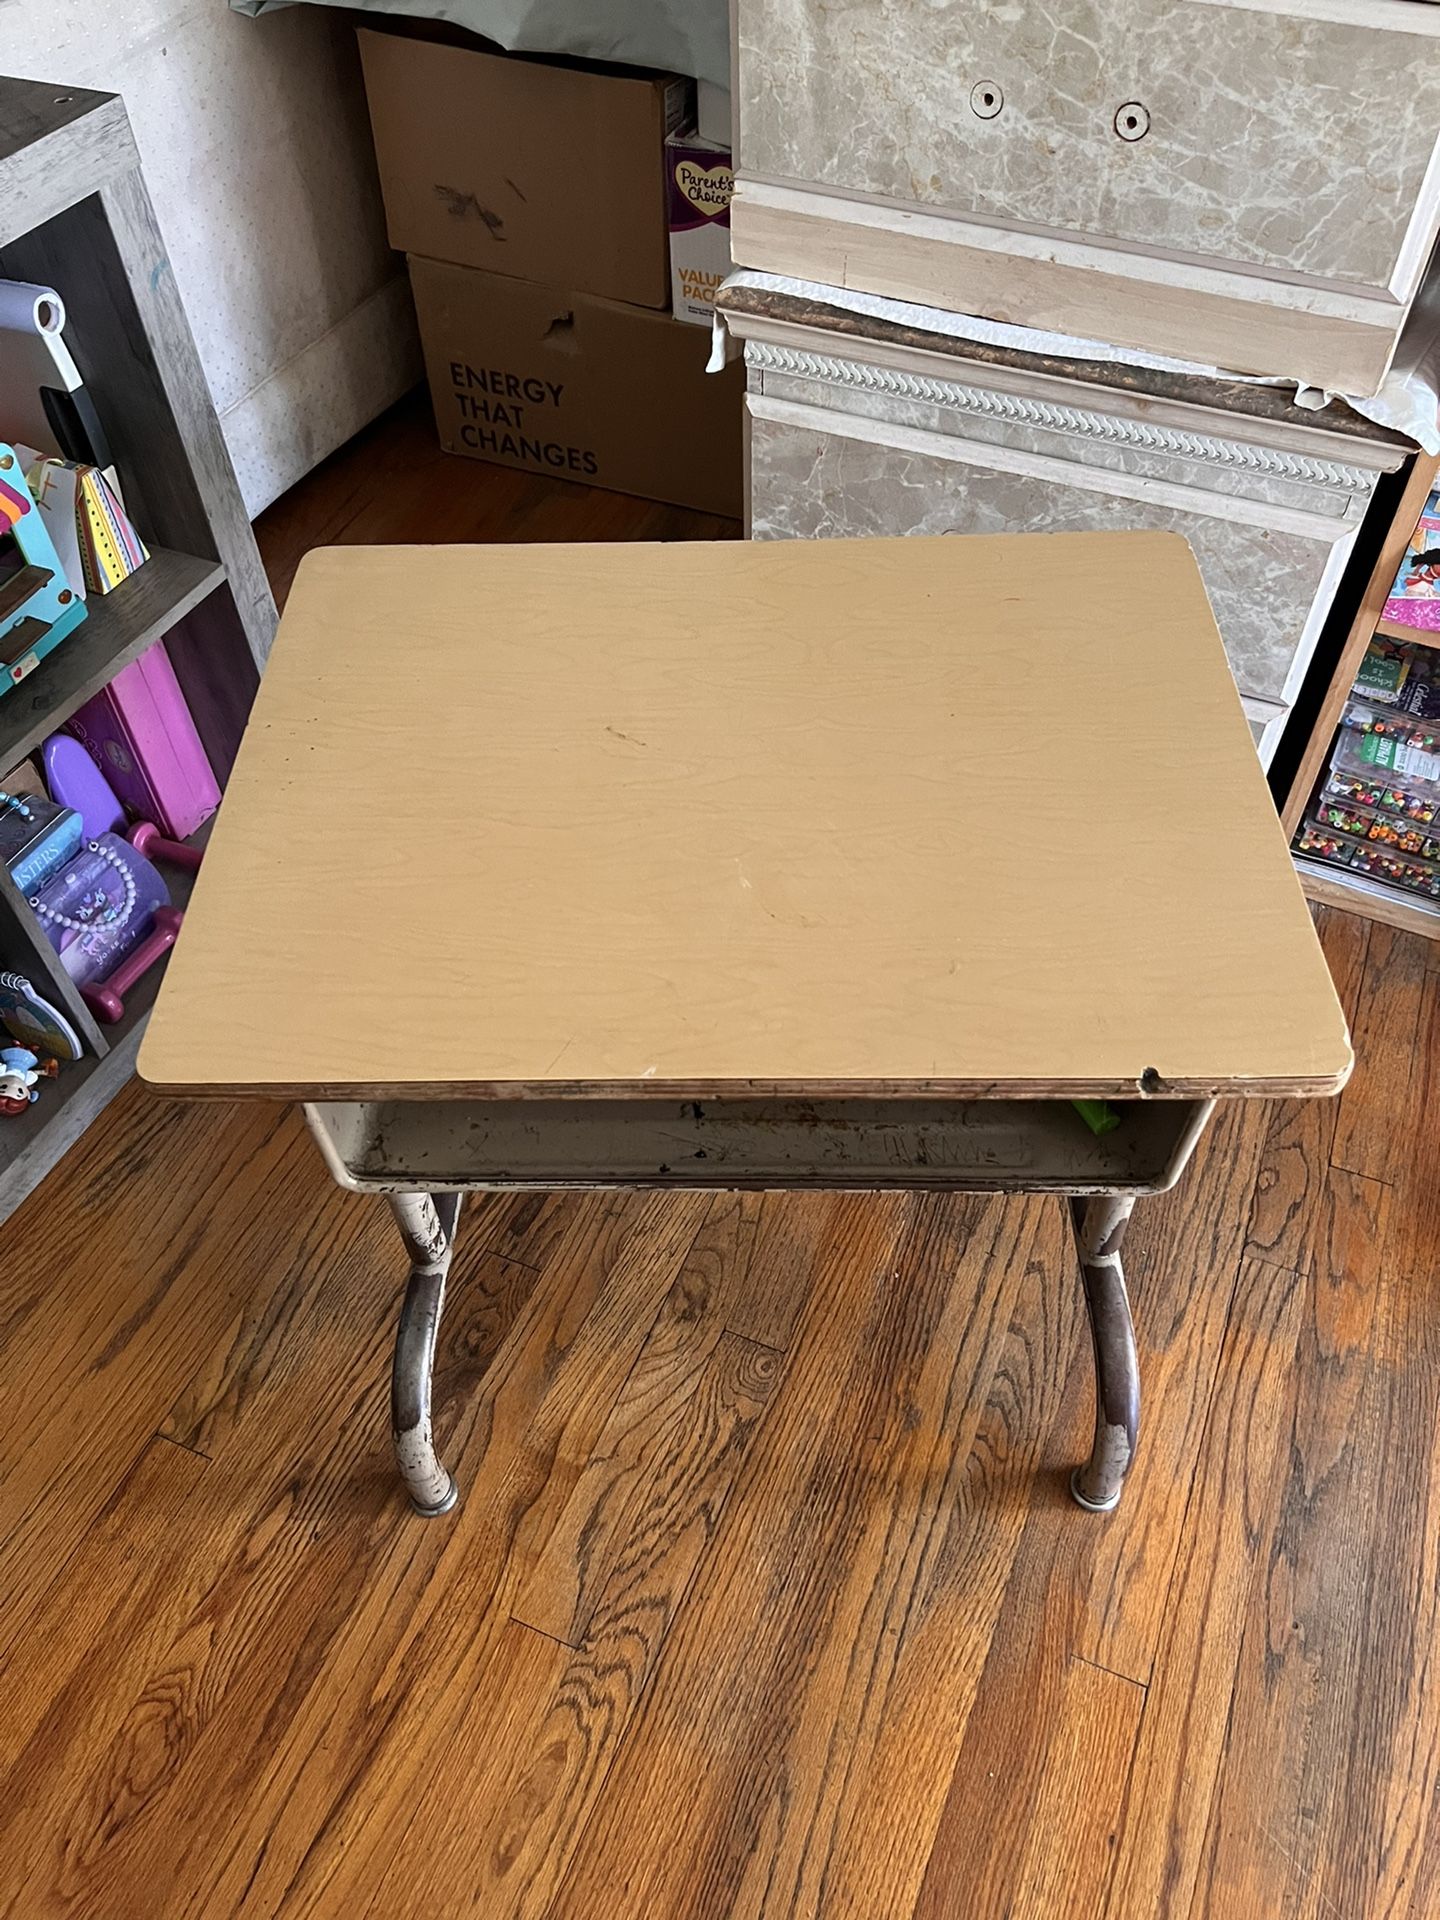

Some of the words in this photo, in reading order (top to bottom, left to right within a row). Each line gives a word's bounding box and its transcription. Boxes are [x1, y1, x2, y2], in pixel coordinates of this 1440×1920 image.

[680, 167, 734, 192] Parent's
[687, 186, 728, 206] Choice
[450, 362, 564, 407] ENERGY
[455, 393, 524, 429] THAT
[460, 424, 598, 475] CHANGES
[15, 843, 60, 888] ISTERS
